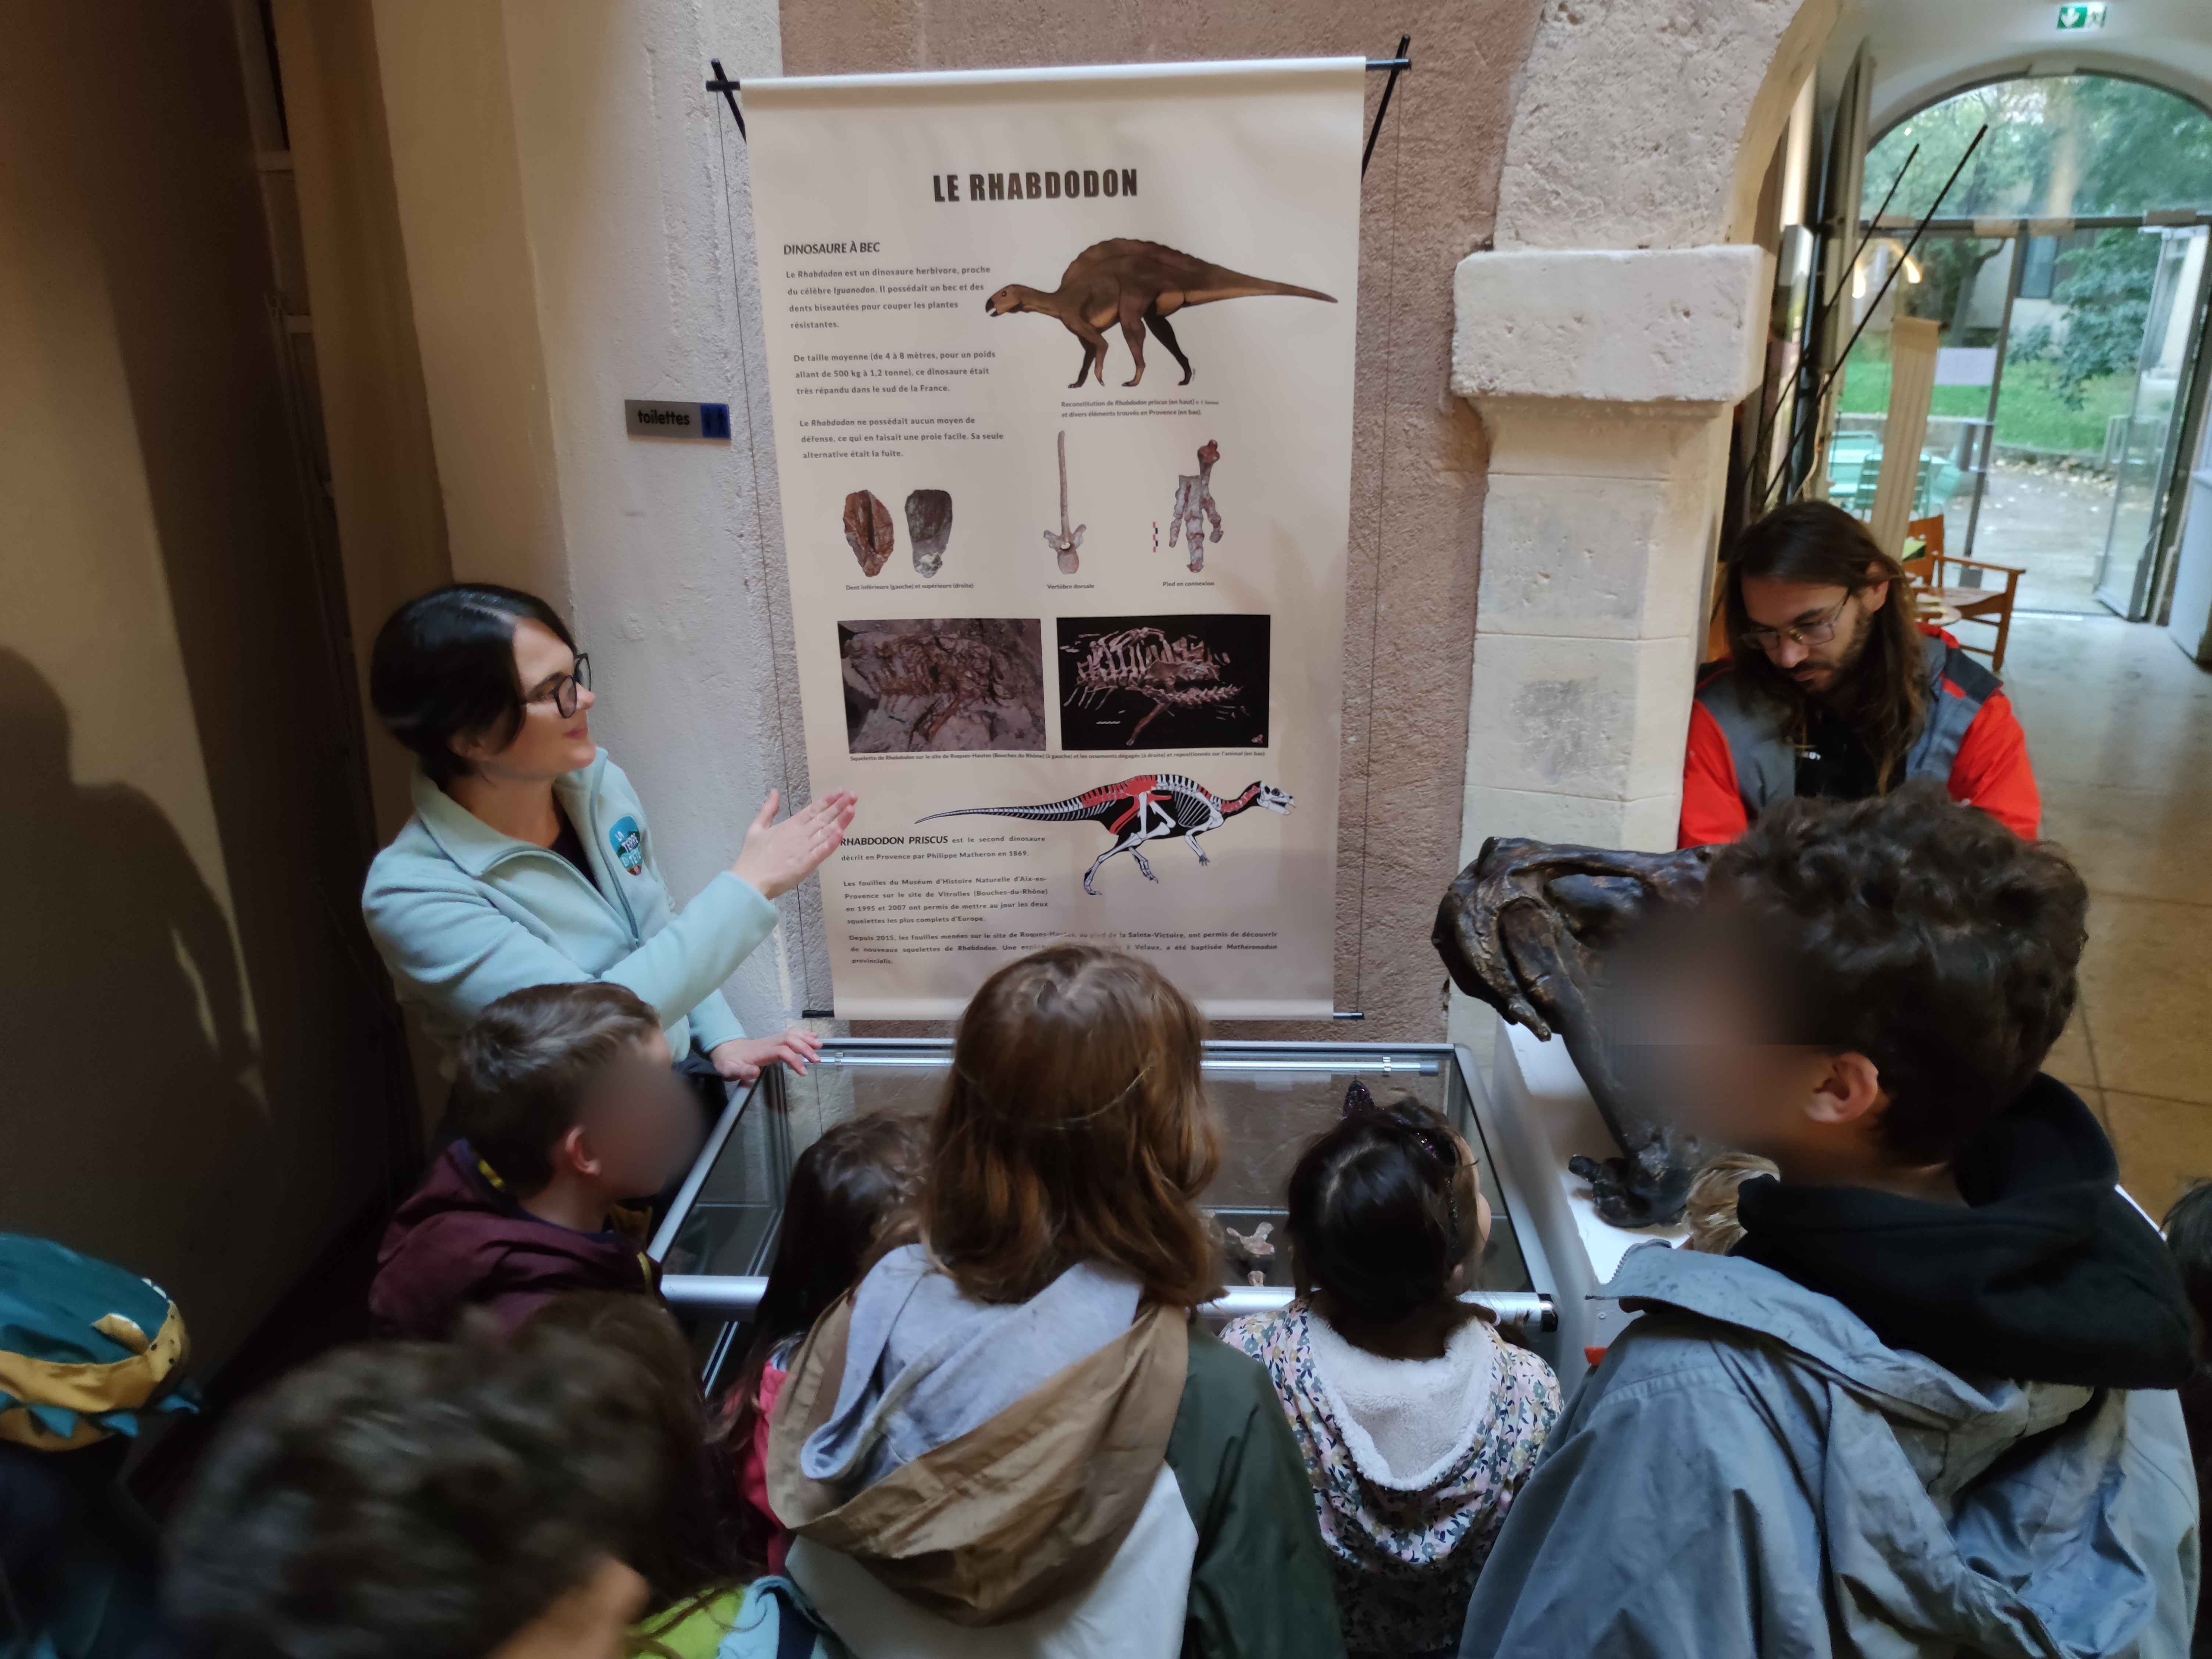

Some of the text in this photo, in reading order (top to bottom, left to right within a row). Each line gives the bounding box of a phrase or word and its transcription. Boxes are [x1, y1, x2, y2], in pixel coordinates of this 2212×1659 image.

[933, 168, 1137, 203] LE RHABDODON
[784, 240, 880, 255] DINOSAURE À BEC
[798, 270, 842, 278] Rhabdodon
[916, 267, 959, 275] herbivore,
[961, 266, 990, 275] proche
[800, 287, 831, 295] célèbre
[888, 284, 928, 294] possédait
[970, 283, 984, 291] des
[814, 303, 859, 311] biseautées
[928, 301, 958, 310] plantes
[807, 354, 829, 362] taille
[870, 353, 883, 361] (de
[973, 350, 996, 359] poids
[851, 370, 861, 378] kg
[870, 369, 882, 377] 1,2
[884, 368, 914, 377] tonne),
[815, 386, 849, 395] répandu
[638, 409, 690, 425] toilettes
[869, 417, 908, 427] possédait
[849, 434, 861, 443] qui
[921, 433, 942, 442] proie
[803, 451, 848, 459] alternative
[614, 831, 625, 842] LA
[840, 837, 904, 846] RHABDODON
[909, 835, 948, 845] PRISCUS
[621, 832, 639, 853] TERRE
[974, 888, 1048, 897] (Bouches-du-Rhône)
